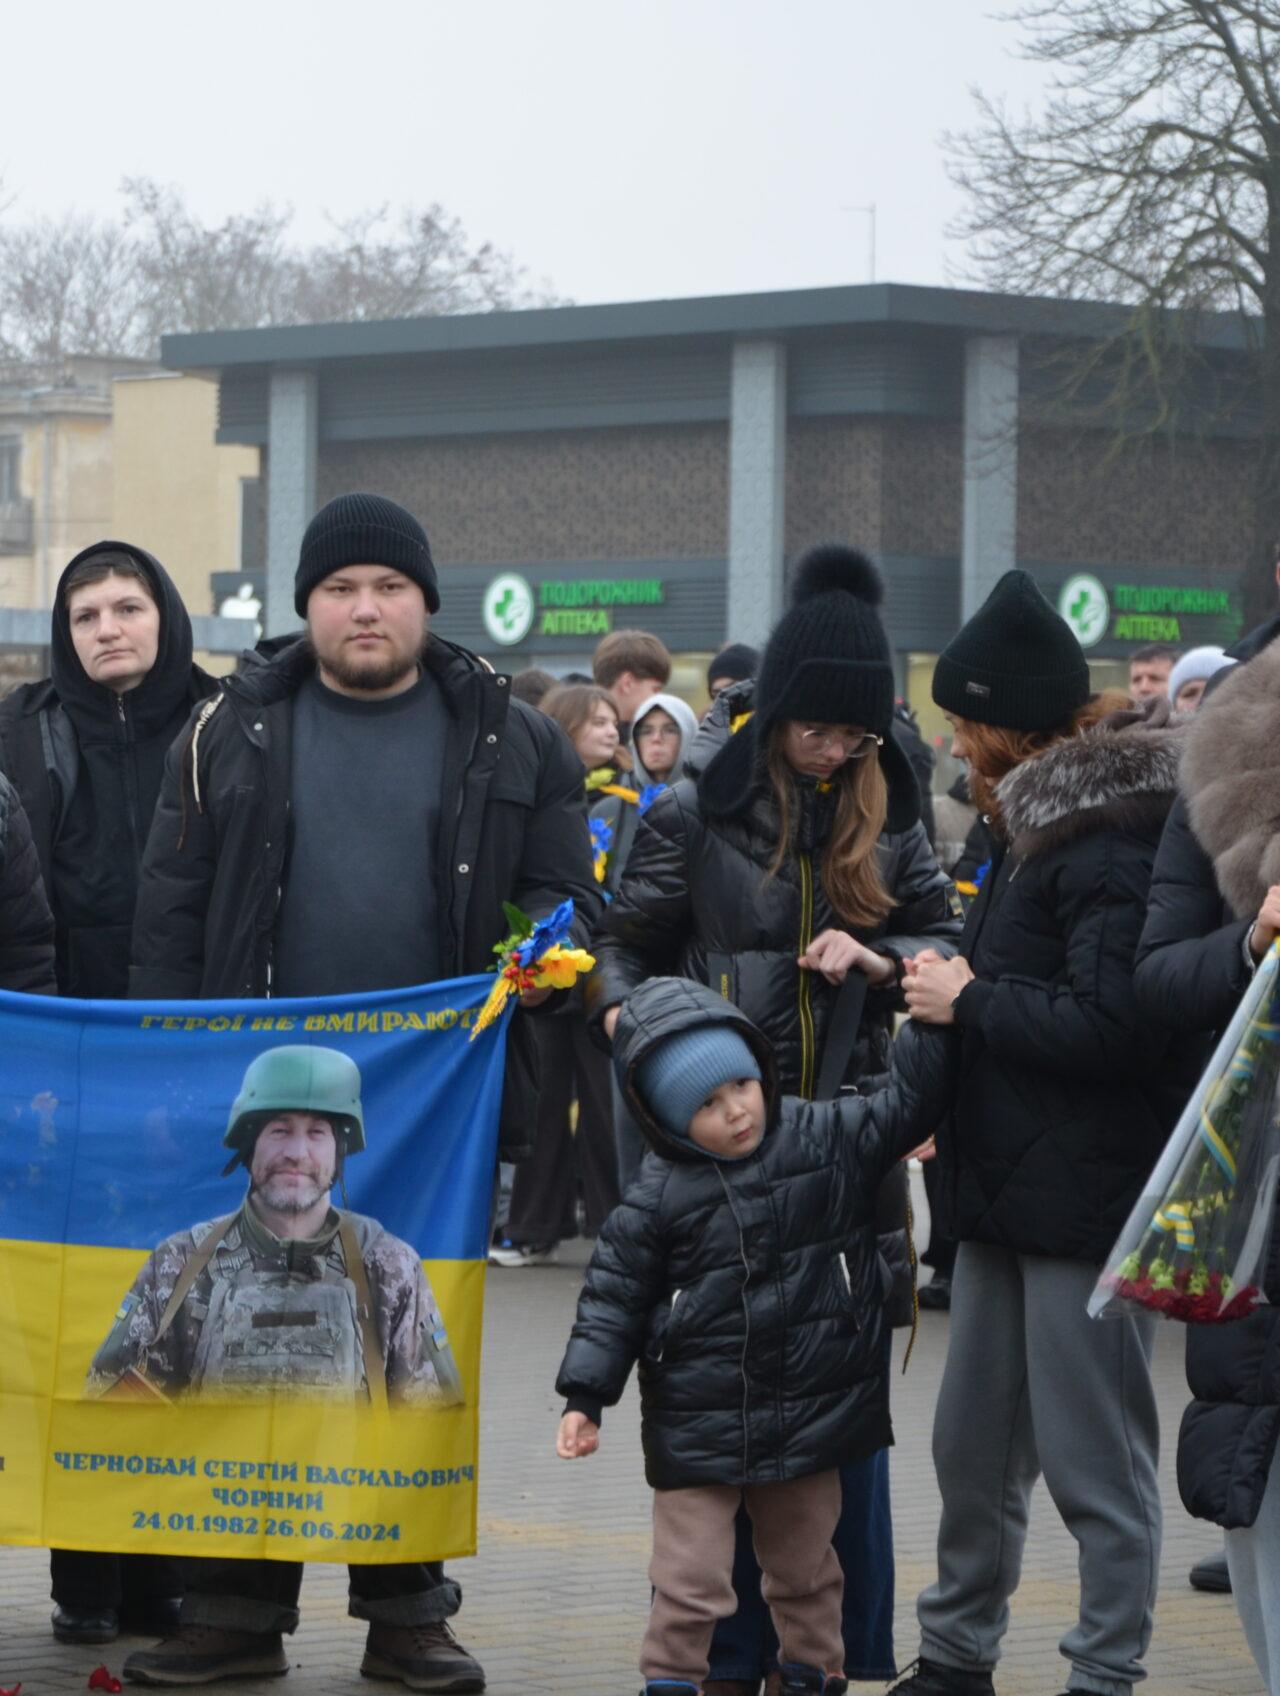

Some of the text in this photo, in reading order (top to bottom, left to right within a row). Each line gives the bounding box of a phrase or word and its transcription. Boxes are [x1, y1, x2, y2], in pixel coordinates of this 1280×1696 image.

[541, 580, 664, 606] ПОДОРОЖНИК
[541, 609, 609, 635] АПТЕКА
[1114, 613, 1181, 641] АПТЕКА
[141, 1007, 495, 1033] ГЕРОЇ НЕ ВМИРАЮТ
[53, 1451, 475, 1488] ЧЕРНОБАЙ СЕРГІЙ ВАСИЛЬОВИЧ
[211, 1486, 324, 1512] ЧОРНИЙ
[132, 1510, 401, 1542] 24.01.1982 26.06.2024
